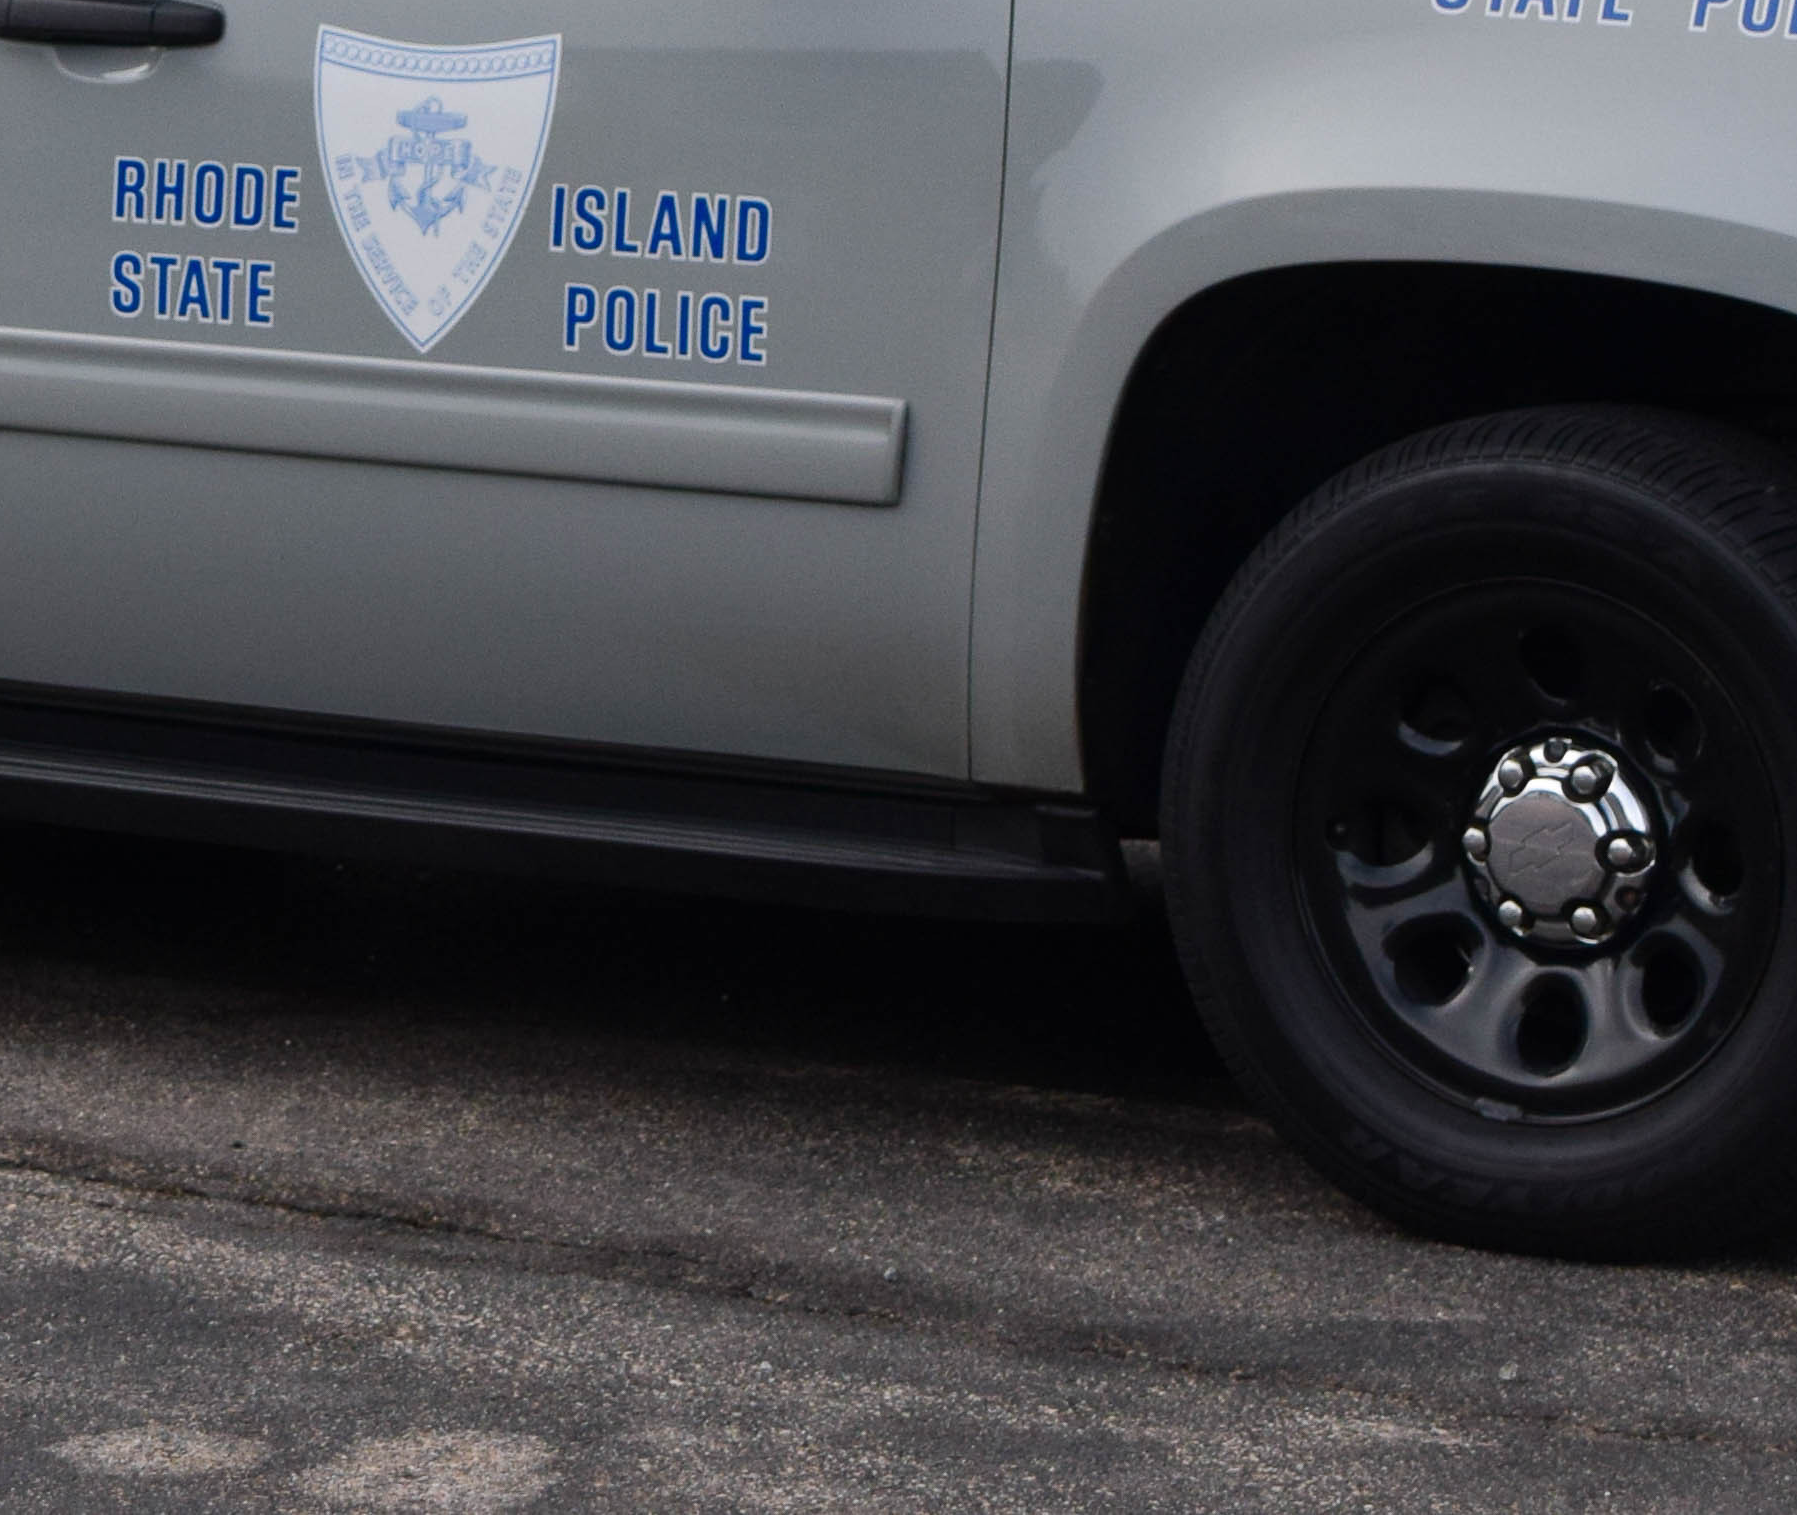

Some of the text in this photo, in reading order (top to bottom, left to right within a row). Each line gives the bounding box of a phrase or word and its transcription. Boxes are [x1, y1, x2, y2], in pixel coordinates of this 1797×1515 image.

[112, 155, 773, 265] RHODE ISLAND
[110, 250, 770, 367] STATE POLICE
